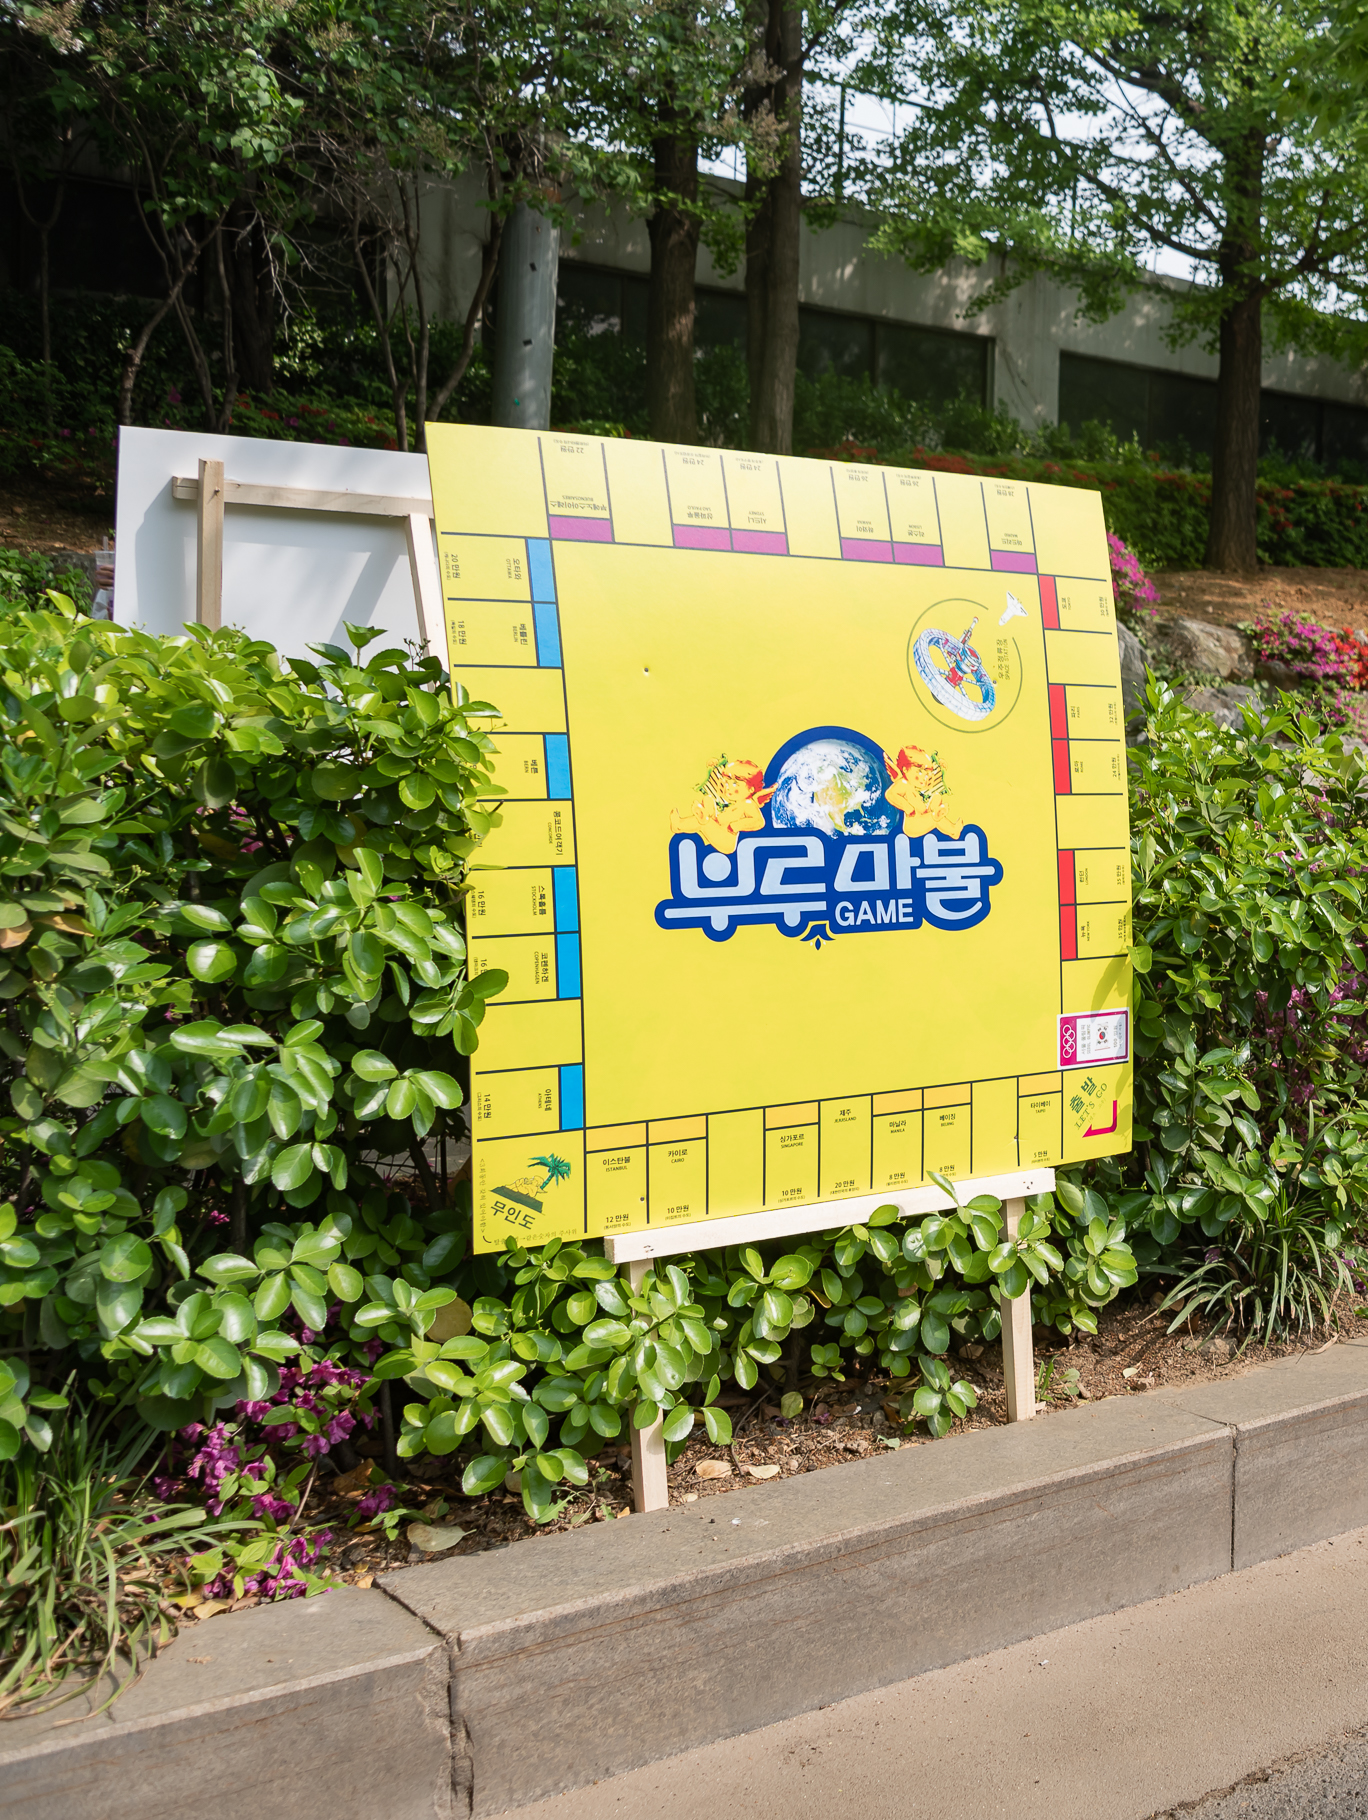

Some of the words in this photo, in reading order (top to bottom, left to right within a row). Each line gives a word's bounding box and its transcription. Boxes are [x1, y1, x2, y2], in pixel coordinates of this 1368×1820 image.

[550, 501, 607, 511] 부에노스아이레스
[748, 516, 766, 524] 시드니
[451, 554, 458, 563] 20
[513, 558, 522, 580] 오타와
[458, 621, 465, 629] 18
[519, 624, 528, 645] 베를린
[1071, 706, 1076, 718] 파리
[531, 760, 538, 774] 베른
[478, 891, 484, 899] 16
[538, 886, 546, 915] 스톡홀름
[834, 898, 915, 926] GAME
[481, 959, 487, 967] 16
[541, 953, 549, 982] 코펜하겐
[484, 1094, 491, 1102] 14
[544, 1089, 552, 1111] 아테네
[1074, 1101, 1095, 1128] LET'S
[1096, 1083, 1107, 1098] GO
[939, 1113, 955, 1121] 베이징
[889, 1120, 906, 1128] 마닐라
[780, 1134, 804, 1143] 싱가포르
[668, 1149, 687, 1157] 카이로
[1038, 1150, 1047, 1158] 만원
[603, 1156, 630, 1166] 이스탄불
[894, 1172, 905, 1180] 만원
[843, 1179, 855, 1187] 만원
[676, 1205, 689, 1213] 만원
[491, 1201, 535, 1230] 무인도
[615, 1214, 629, 1222] 만원
